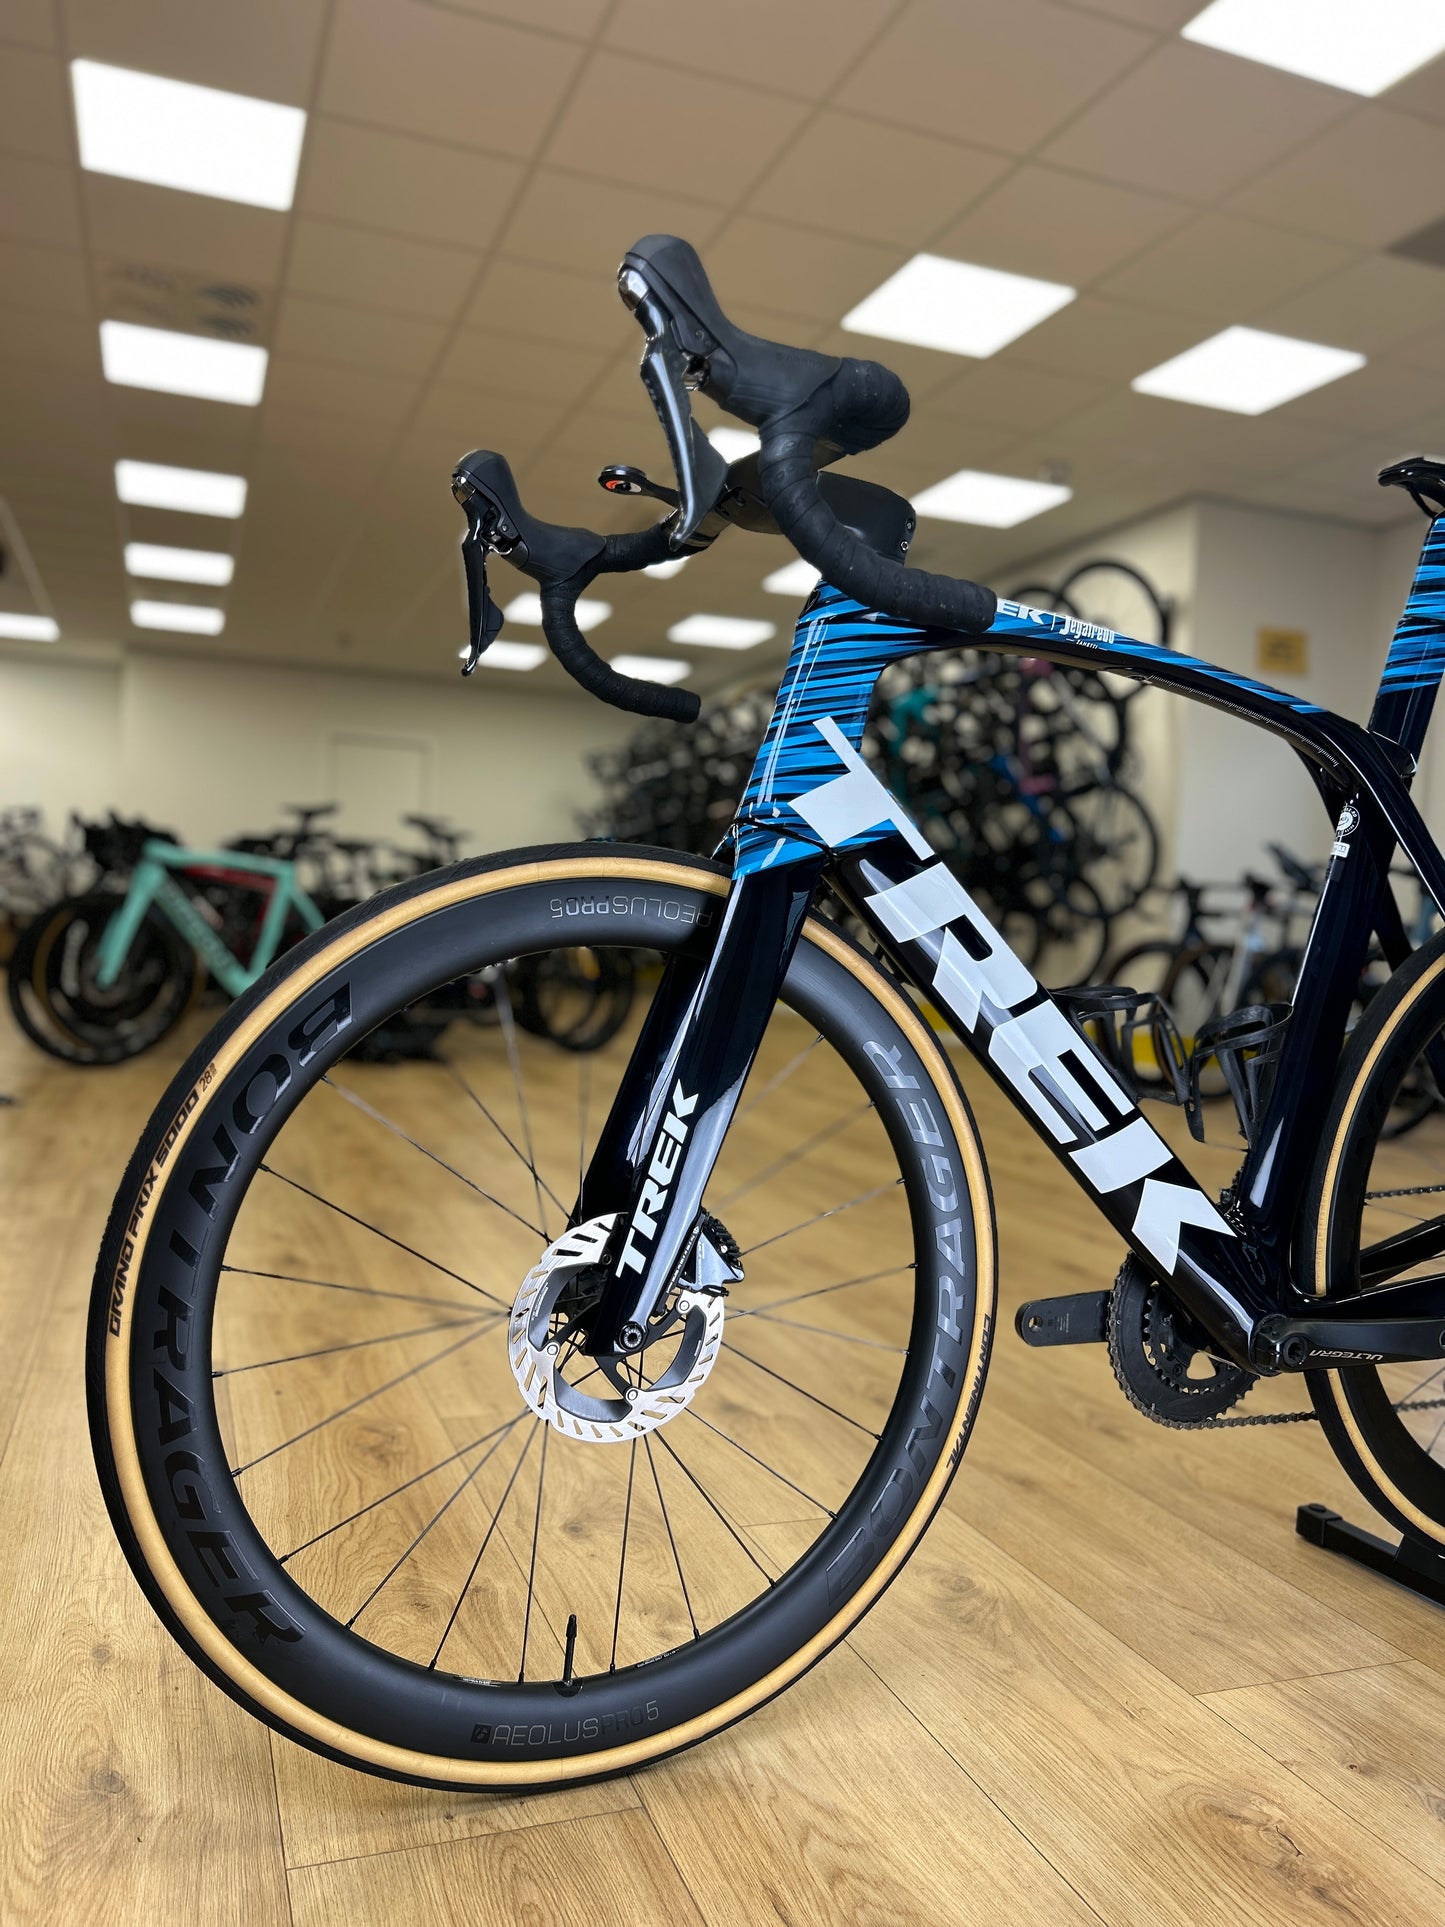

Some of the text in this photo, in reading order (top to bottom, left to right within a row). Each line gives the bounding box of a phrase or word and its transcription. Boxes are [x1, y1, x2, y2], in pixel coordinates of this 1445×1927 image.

[787, 716, 1237, 1276] TREK
[108, 1242, 135, 1338] GRAND
[128, 1170, 160, 1238] PRIX
[155, 1089, 201, 1167] 5000
[615, 1078, 699, 1279] TREK
[825, 1040, 967, 1608] BONTRAGER
[946, 1313, 992, 1469] CONTINENTAL
[1309, 1349, 1384, 1361] ULTEGRA
